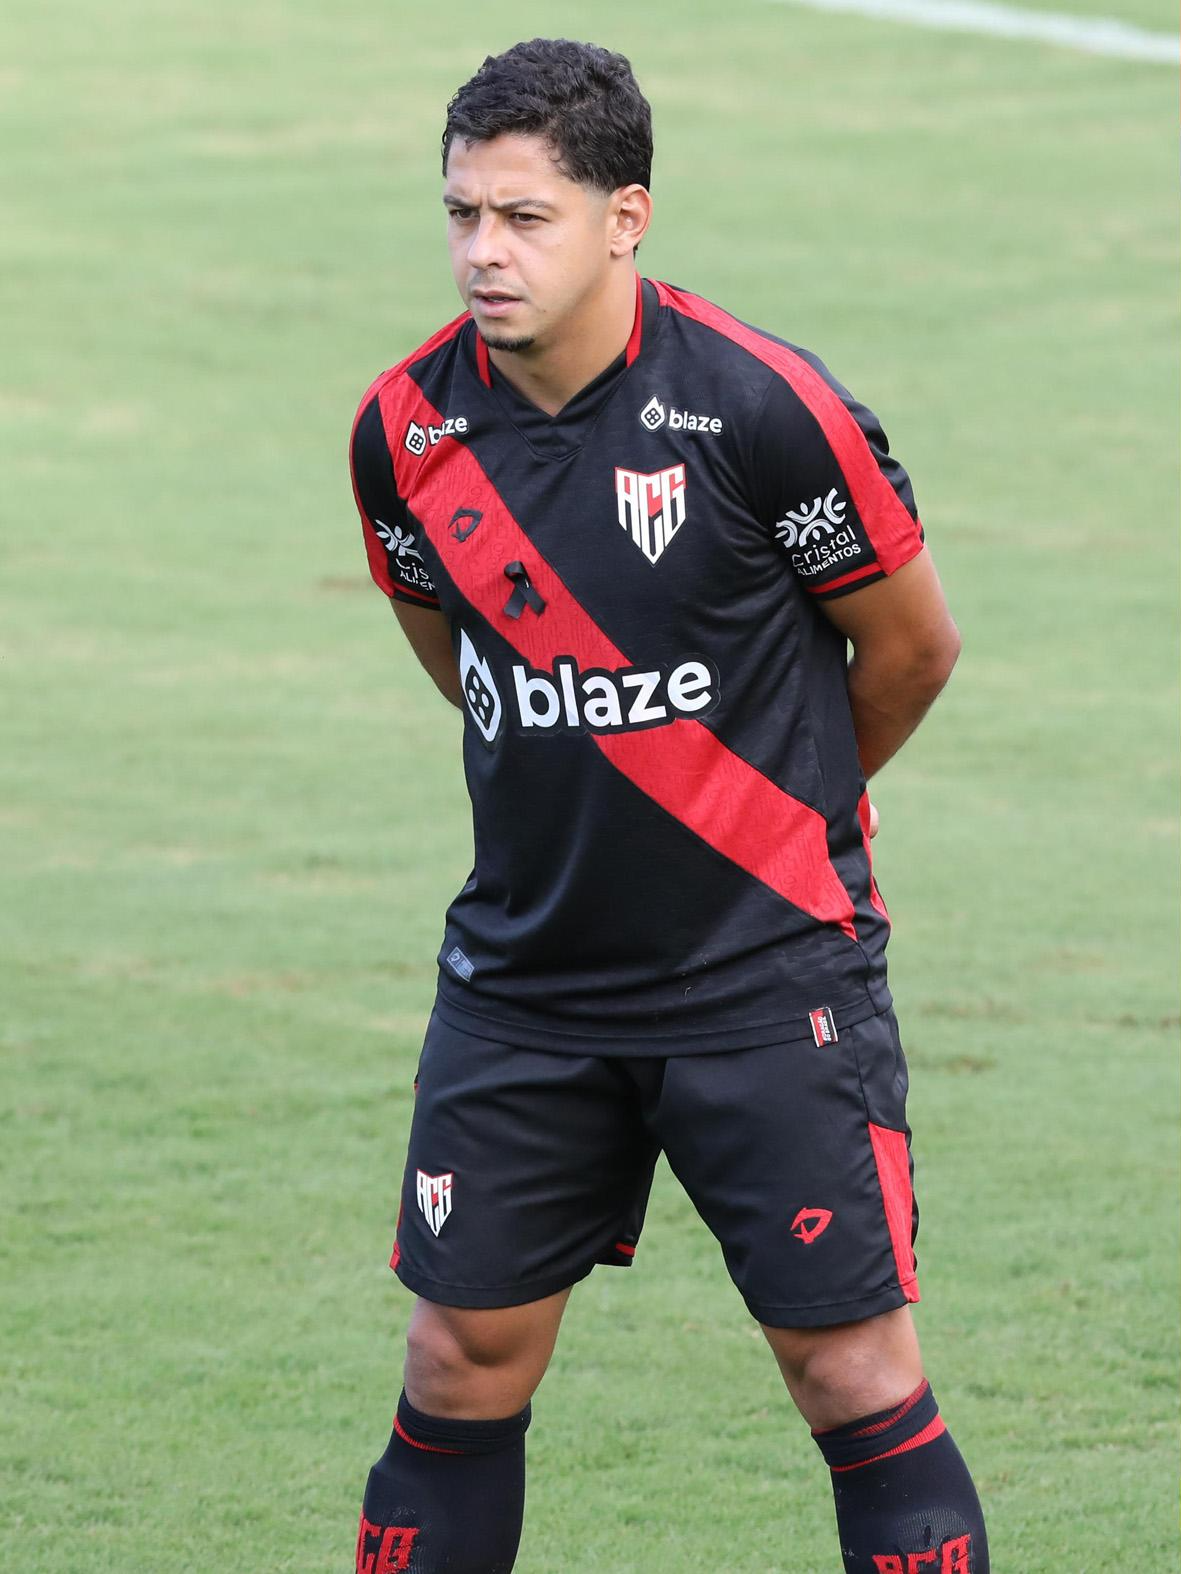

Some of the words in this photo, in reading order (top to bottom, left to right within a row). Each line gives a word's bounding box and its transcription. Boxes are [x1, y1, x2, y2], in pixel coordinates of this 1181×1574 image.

[669, 409, 723, 433] blaze
[797, 543, 862, 576] ALIMENTOS
[512, 661, 712, 728] blaze
